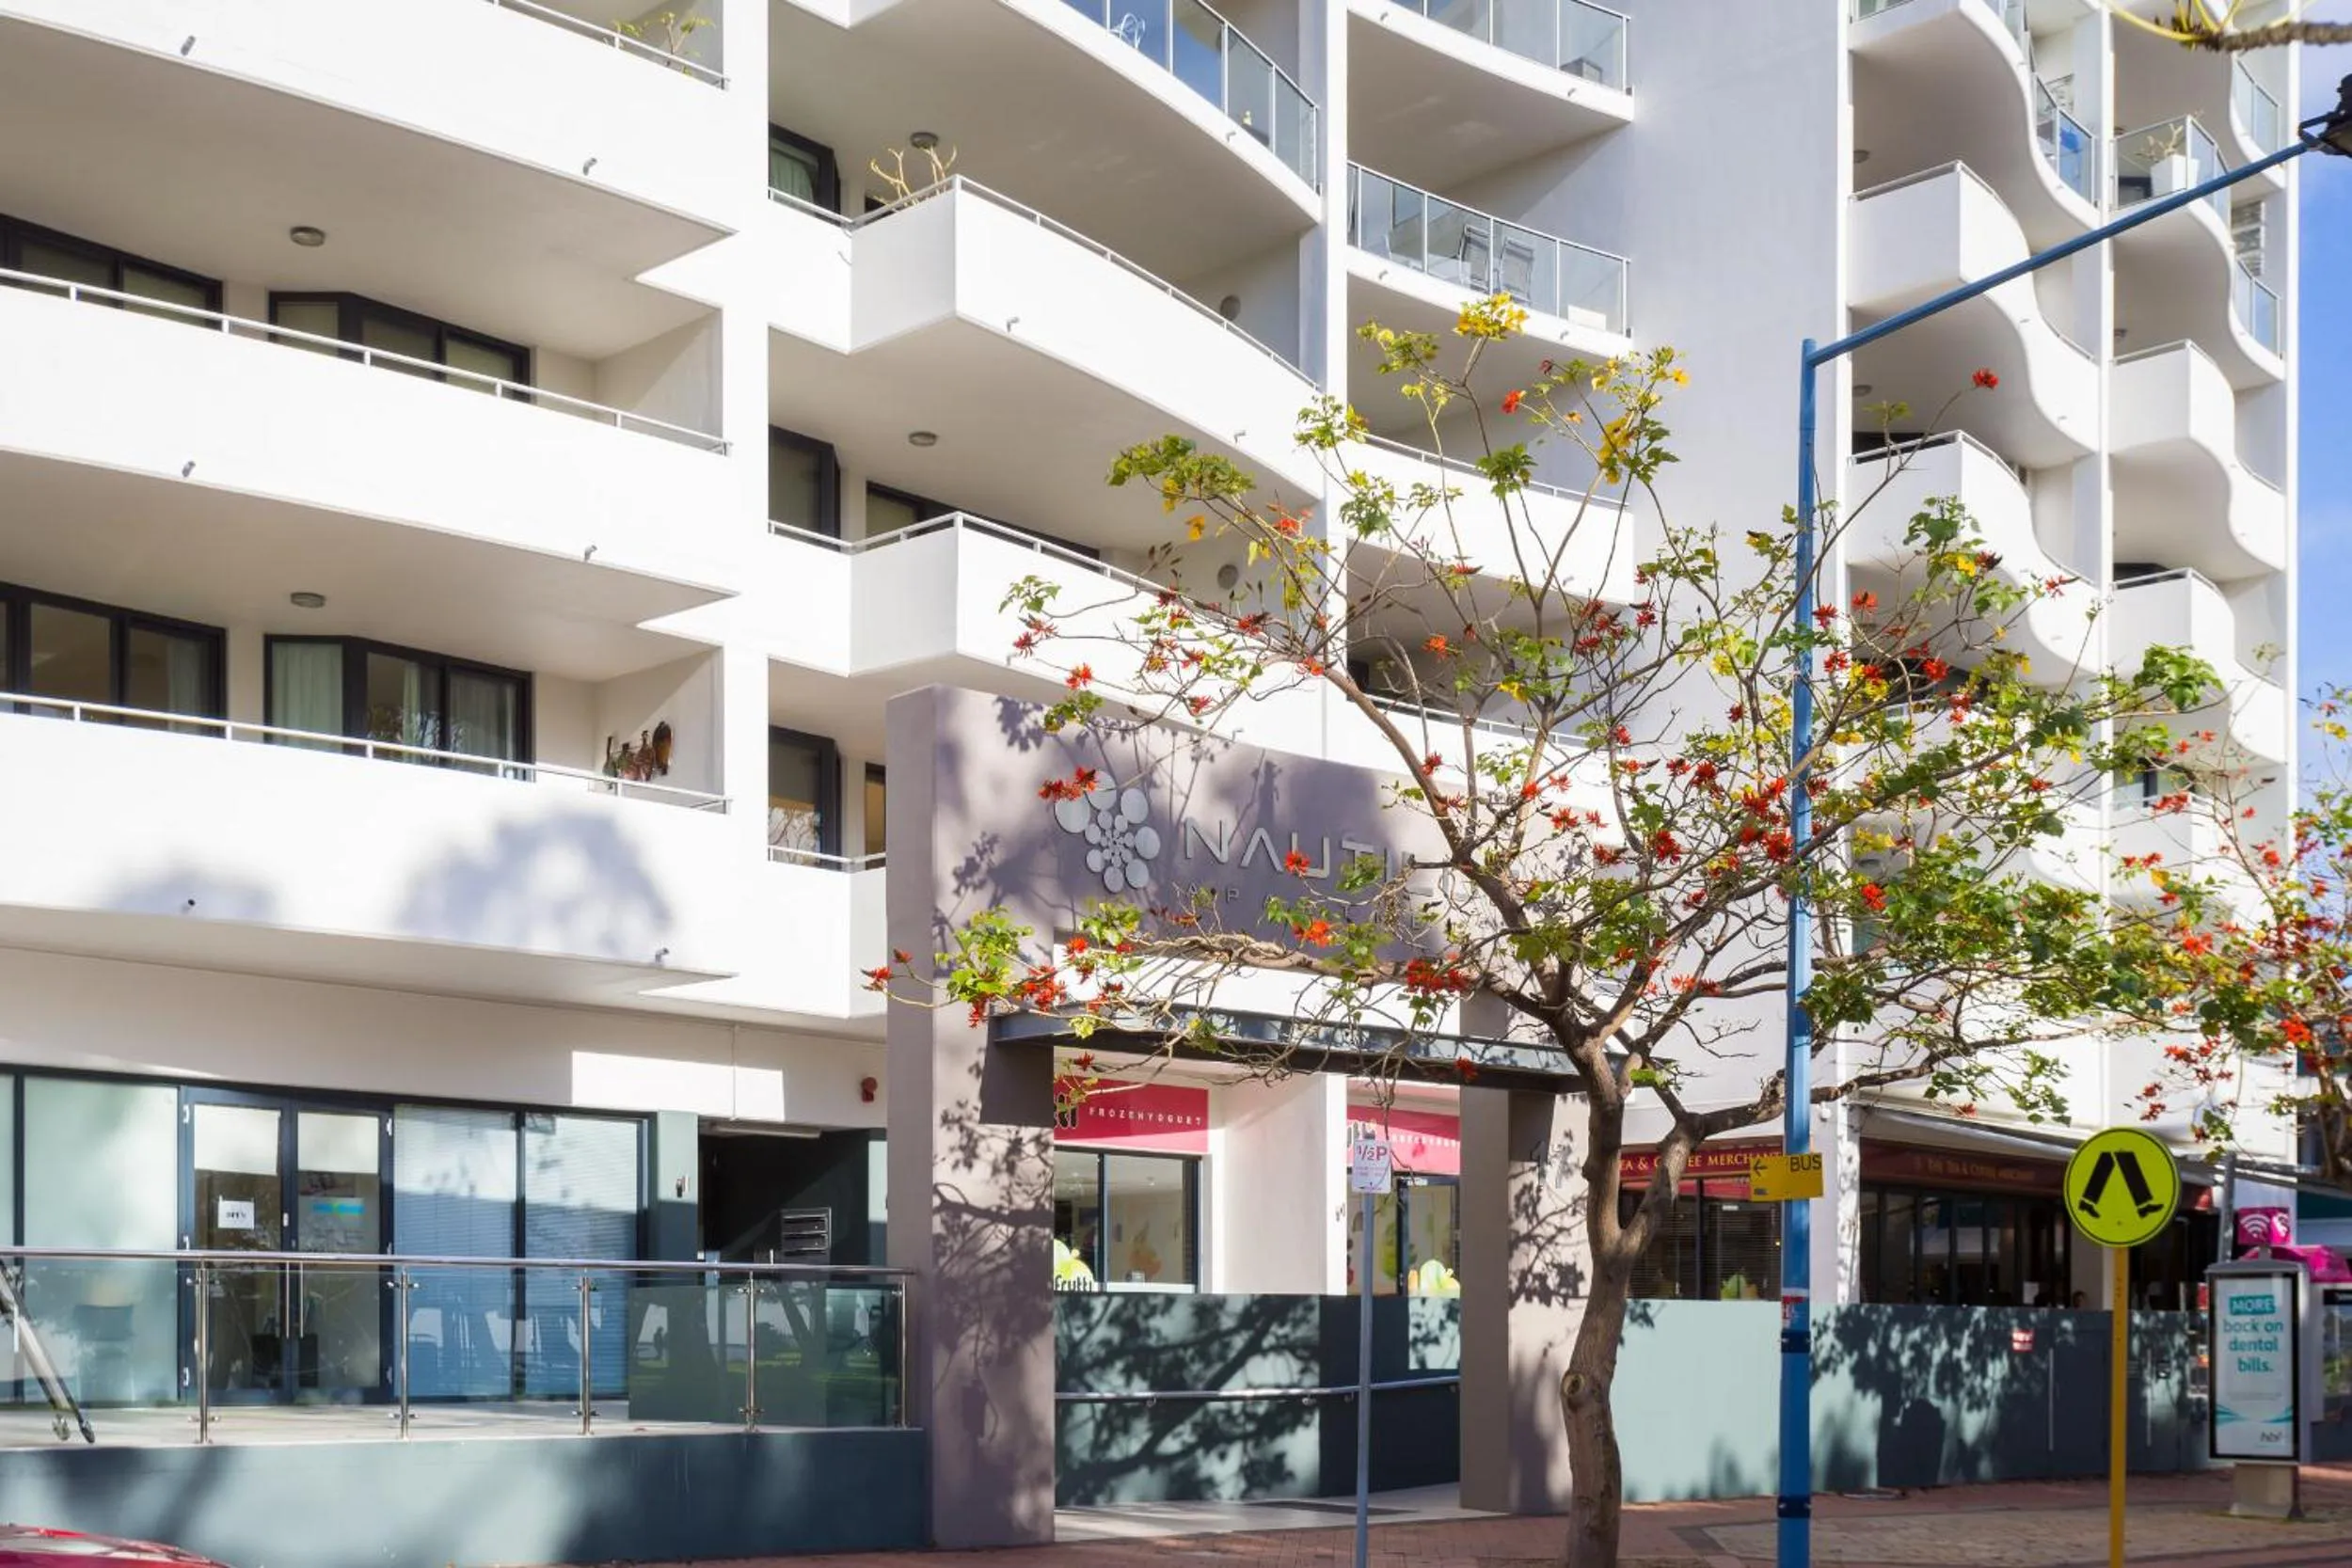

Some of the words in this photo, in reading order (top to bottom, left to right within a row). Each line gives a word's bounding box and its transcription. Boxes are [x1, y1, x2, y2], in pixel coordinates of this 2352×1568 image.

[1790, 1155, 1821, 1172] BUS
[2232, 1298, 2275, 1311] MORE
[2223, 1320, 2259, 1333] back
[2264, 1321, 2283, 1333] on
[2229, 1337, 2279, 1352] dental
[2237, 1357, 2274, 1371] bills.
